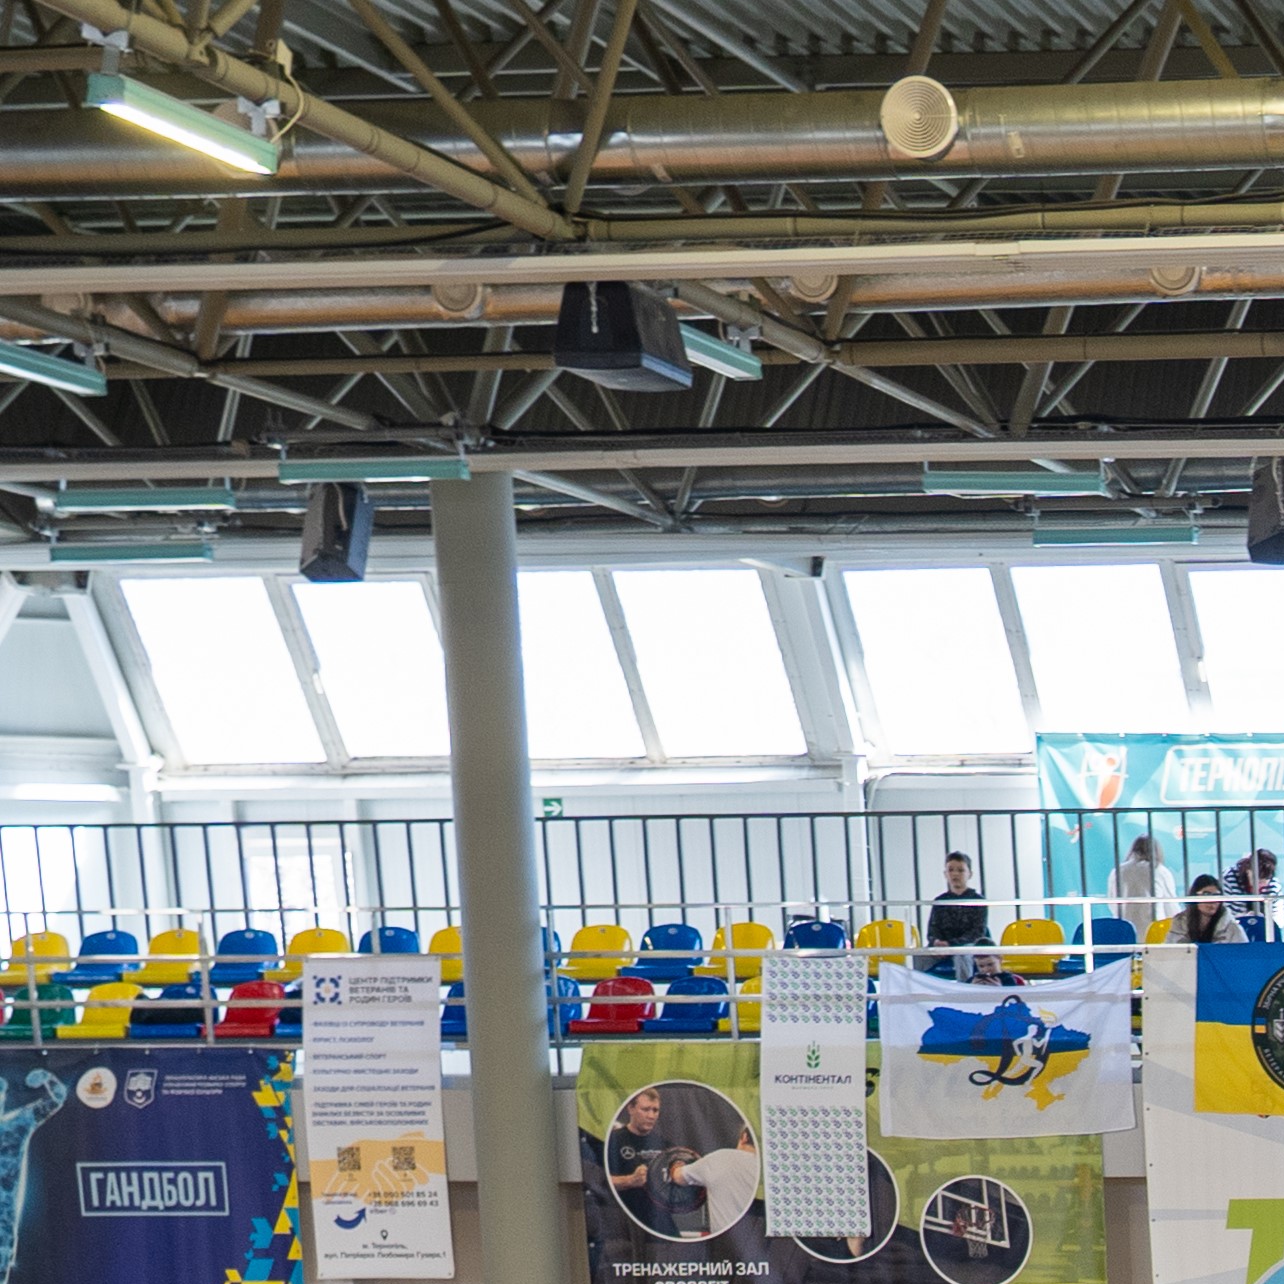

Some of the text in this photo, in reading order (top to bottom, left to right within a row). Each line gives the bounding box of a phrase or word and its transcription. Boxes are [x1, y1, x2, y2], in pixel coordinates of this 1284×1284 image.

[349, 986, 396, 994] ВЕТЕРАНІВ
[89, 1171, 217, 1211] ГАНДБОЛ
[612, 1260, 769, 1277] ТРЕНАЖЕРНИЙ ЗАЛ
